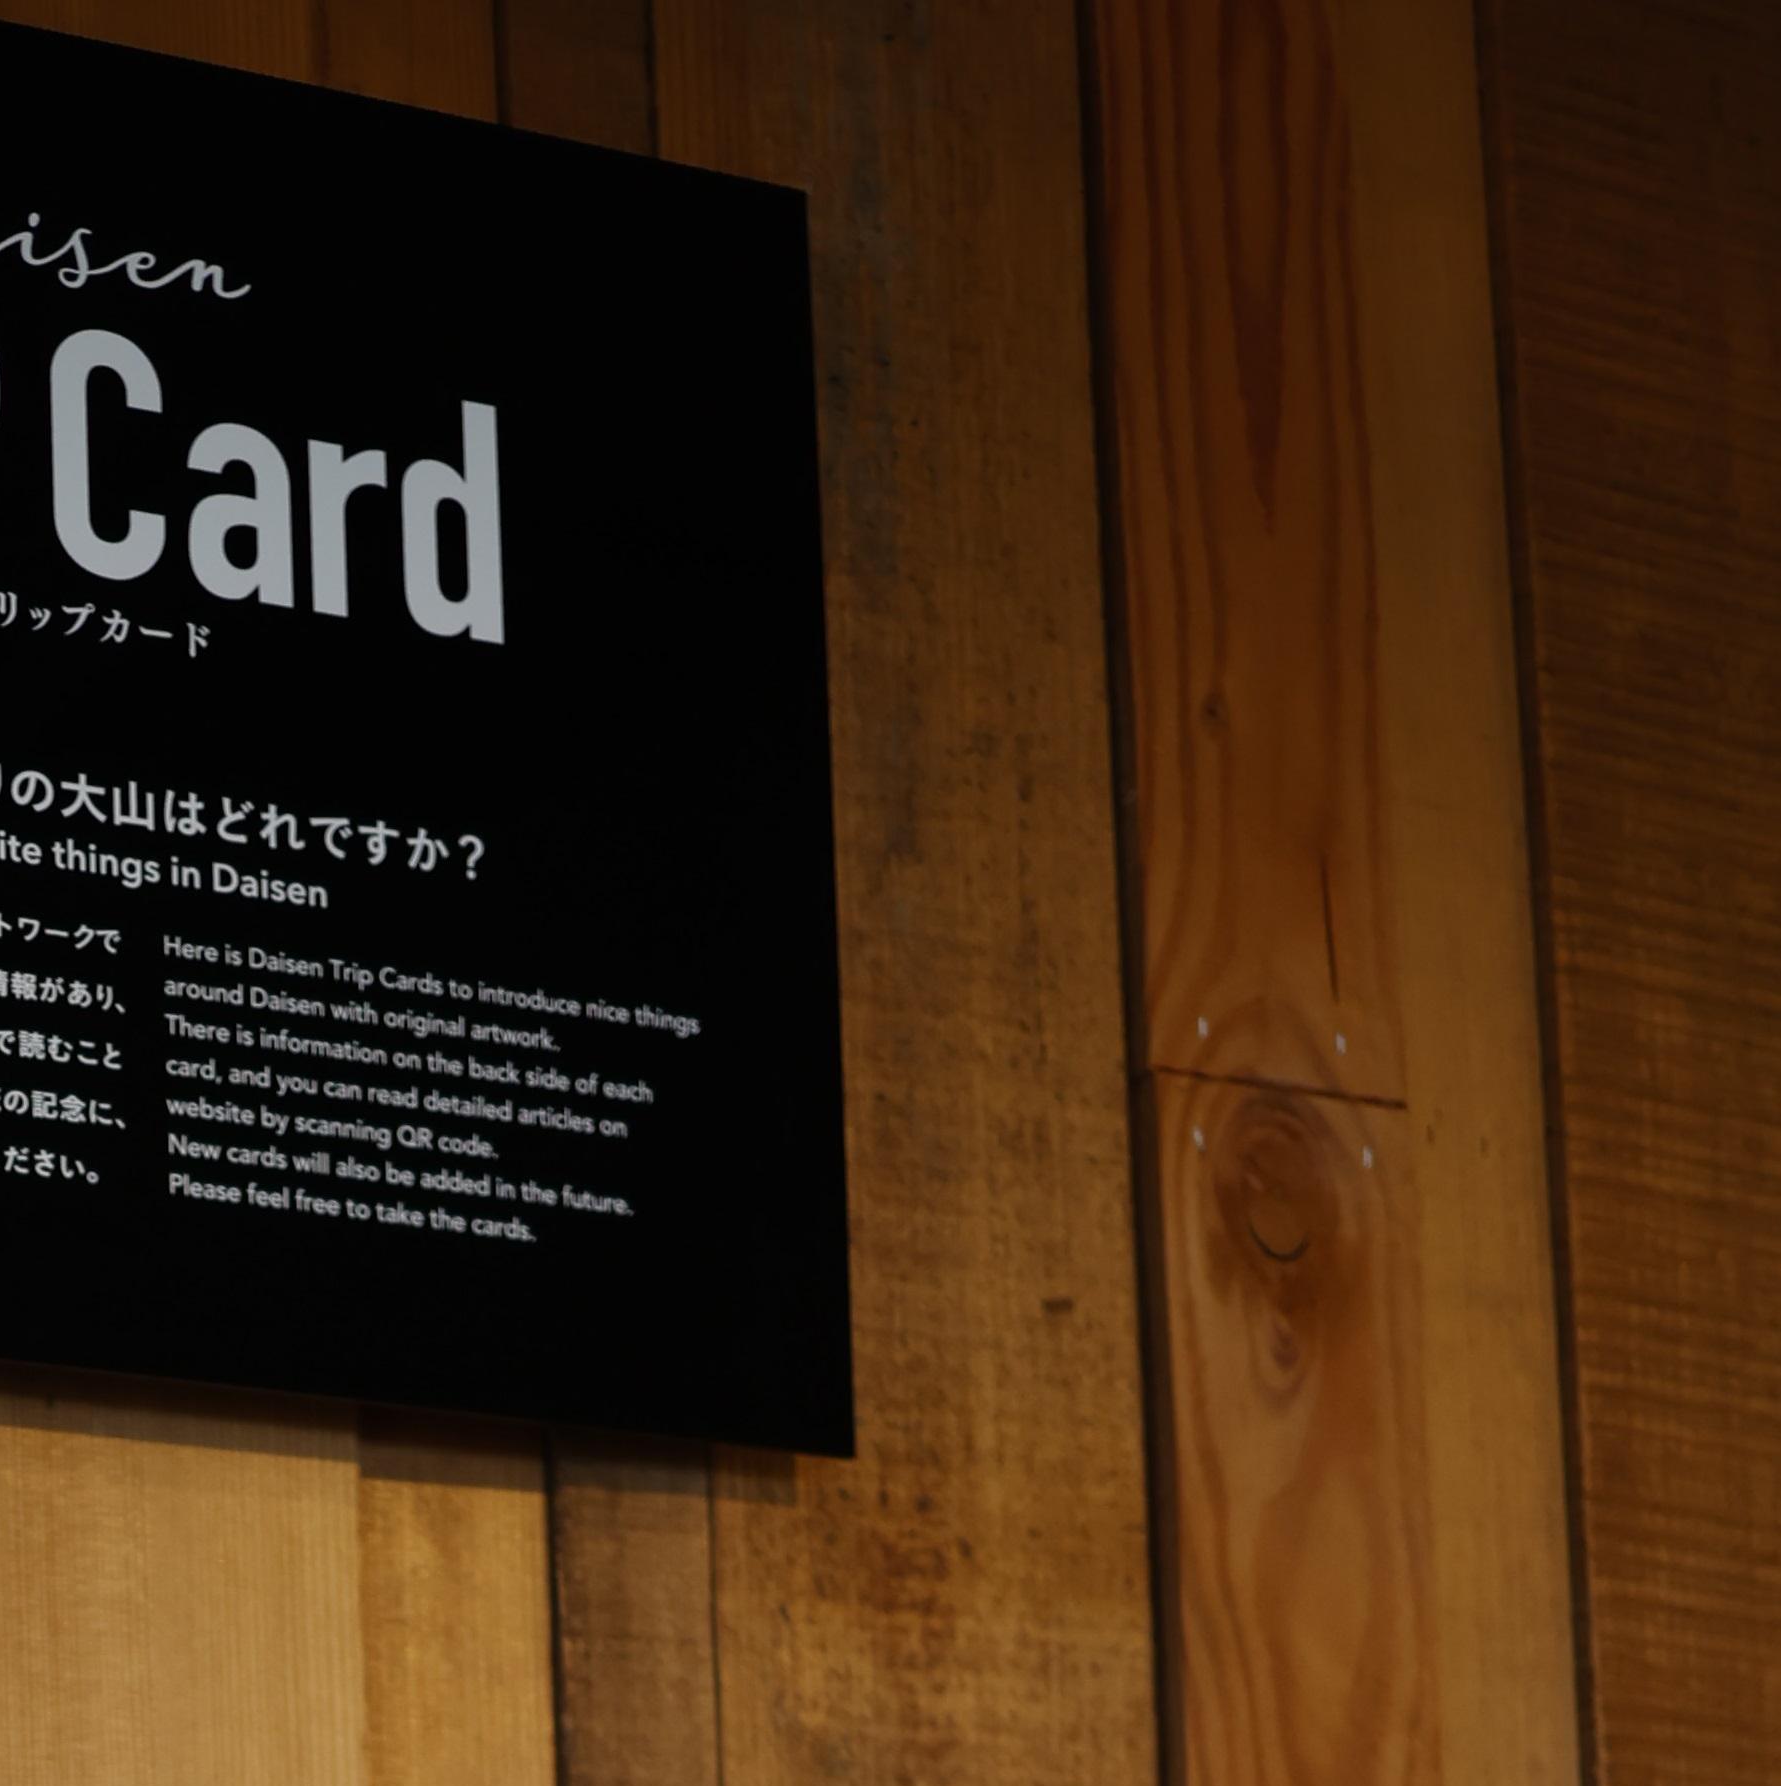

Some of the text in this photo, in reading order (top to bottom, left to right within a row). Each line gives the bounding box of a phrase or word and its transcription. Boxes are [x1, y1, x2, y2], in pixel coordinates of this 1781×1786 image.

[49, 329, 506, 646] Card
[51, 838, 161, 889] things
[170, 855, 202, 889] in
[212, 862, 328, 909] Daisen
[163, 935, 700, 1038] Here is Daisen Trip Cards to introduce nice things
[163, 980, 560, 1050] around Daisen with original artwork.
[164, 1013, 653, 1102] There is information on the back side of each
[165, 1058, 628, 1137] card, and you can read detailed articles on
[165, 1096, 499, 1158] website by scanning QR code.
[168, 1132, 634, 1215] New cards will also be added in the future.
[168, 1172, 536, 1241] Please feel free to take the cards.
